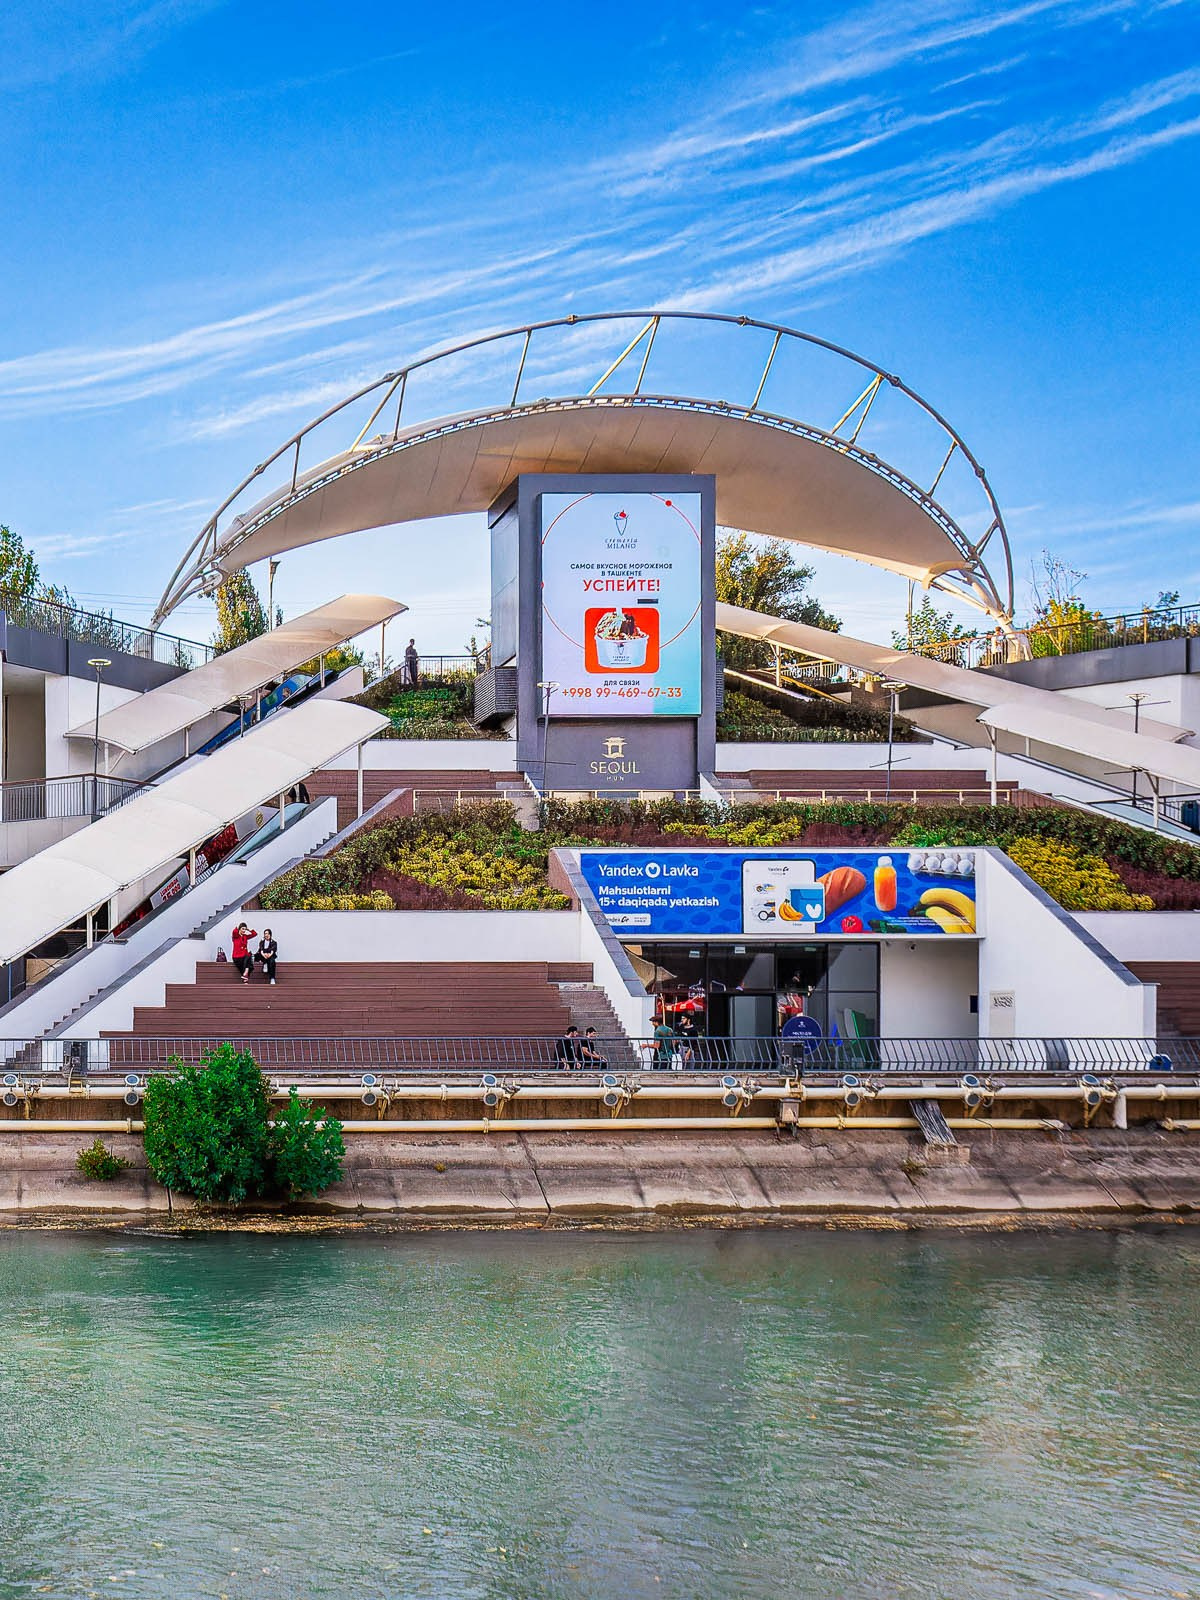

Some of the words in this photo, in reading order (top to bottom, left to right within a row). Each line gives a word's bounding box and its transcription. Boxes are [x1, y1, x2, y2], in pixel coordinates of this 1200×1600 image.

[583, 576, 660, 592] УСПЕЙТЕ!
[562, 687, 592, 698] +998
[596, 687, 682, 698] 99-469-67-33
[590, 761, 640, 774] SEOUL
[598, 864, 644, 877] Yandex
[662, 864, 699, 877] Lavka
[598, 885, 671, 895] Mahsulotlarni
[599, 897, 616, 906] 15+
[618, 897, 668, 908] daqiqada
[669, 896, 720, 908] yetkazish
